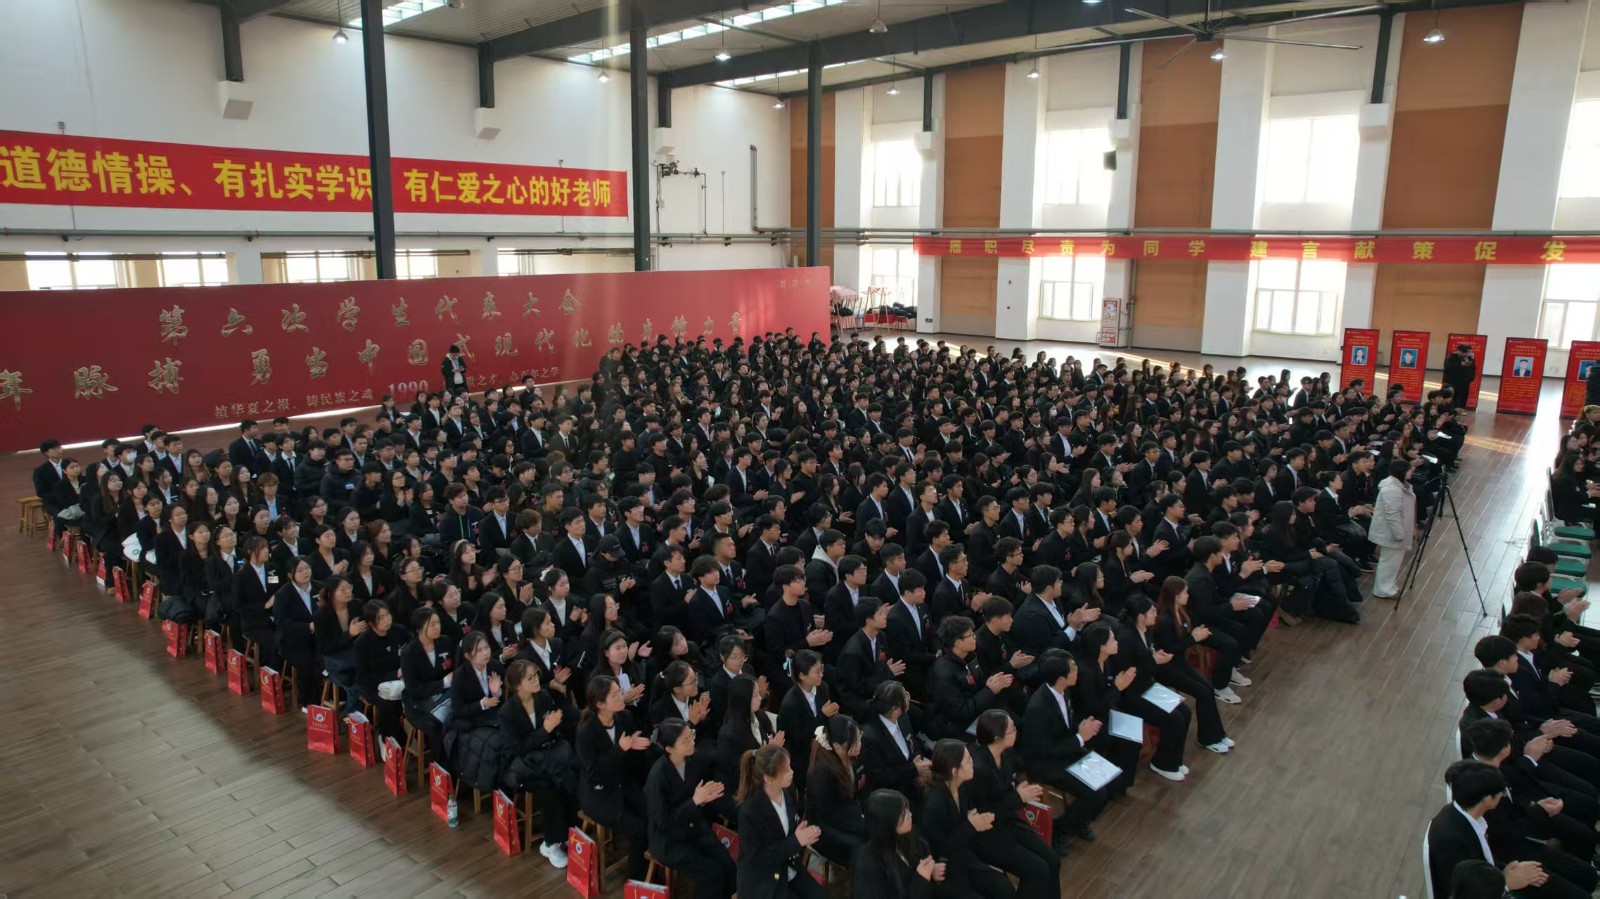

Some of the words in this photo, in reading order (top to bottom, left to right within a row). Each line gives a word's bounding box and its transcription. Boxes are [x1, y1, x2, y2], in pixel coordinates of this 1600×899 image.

[404, 168, 611, 208] 有仁爱之心的好老师
